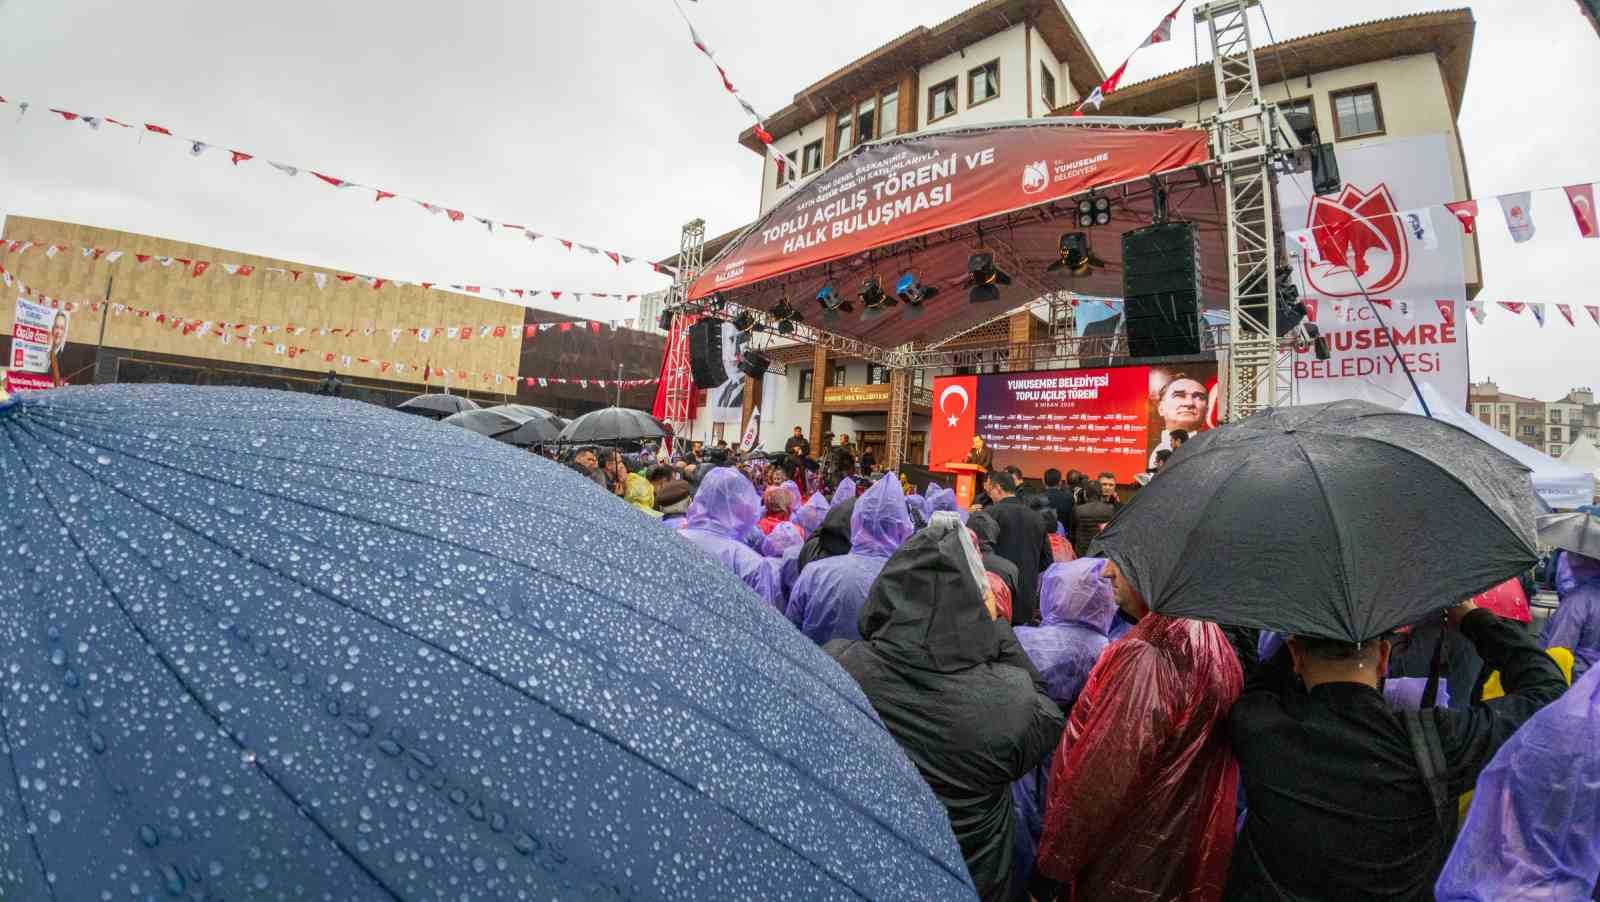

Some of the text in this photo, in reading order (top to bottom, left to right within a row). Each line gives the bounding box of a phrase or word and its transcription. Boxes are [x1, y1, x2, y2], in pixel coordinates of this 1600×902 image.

[1054, 152, 1109, 174] YUNUSEMRE
[761, 147, 995, 244] TOPLU AÇILIŞ TÖRENİ VE
[782, 183, 952, 255] HALK BULUŞMASI
[1288, 323, 1457, 354] USEMRE
[1008, 372, 1109, 390] YUNUSEMRE BELEDİYESİ
[1016, 386, 1098, 401] TOPLU AÇILIŞ TÖRENİ
